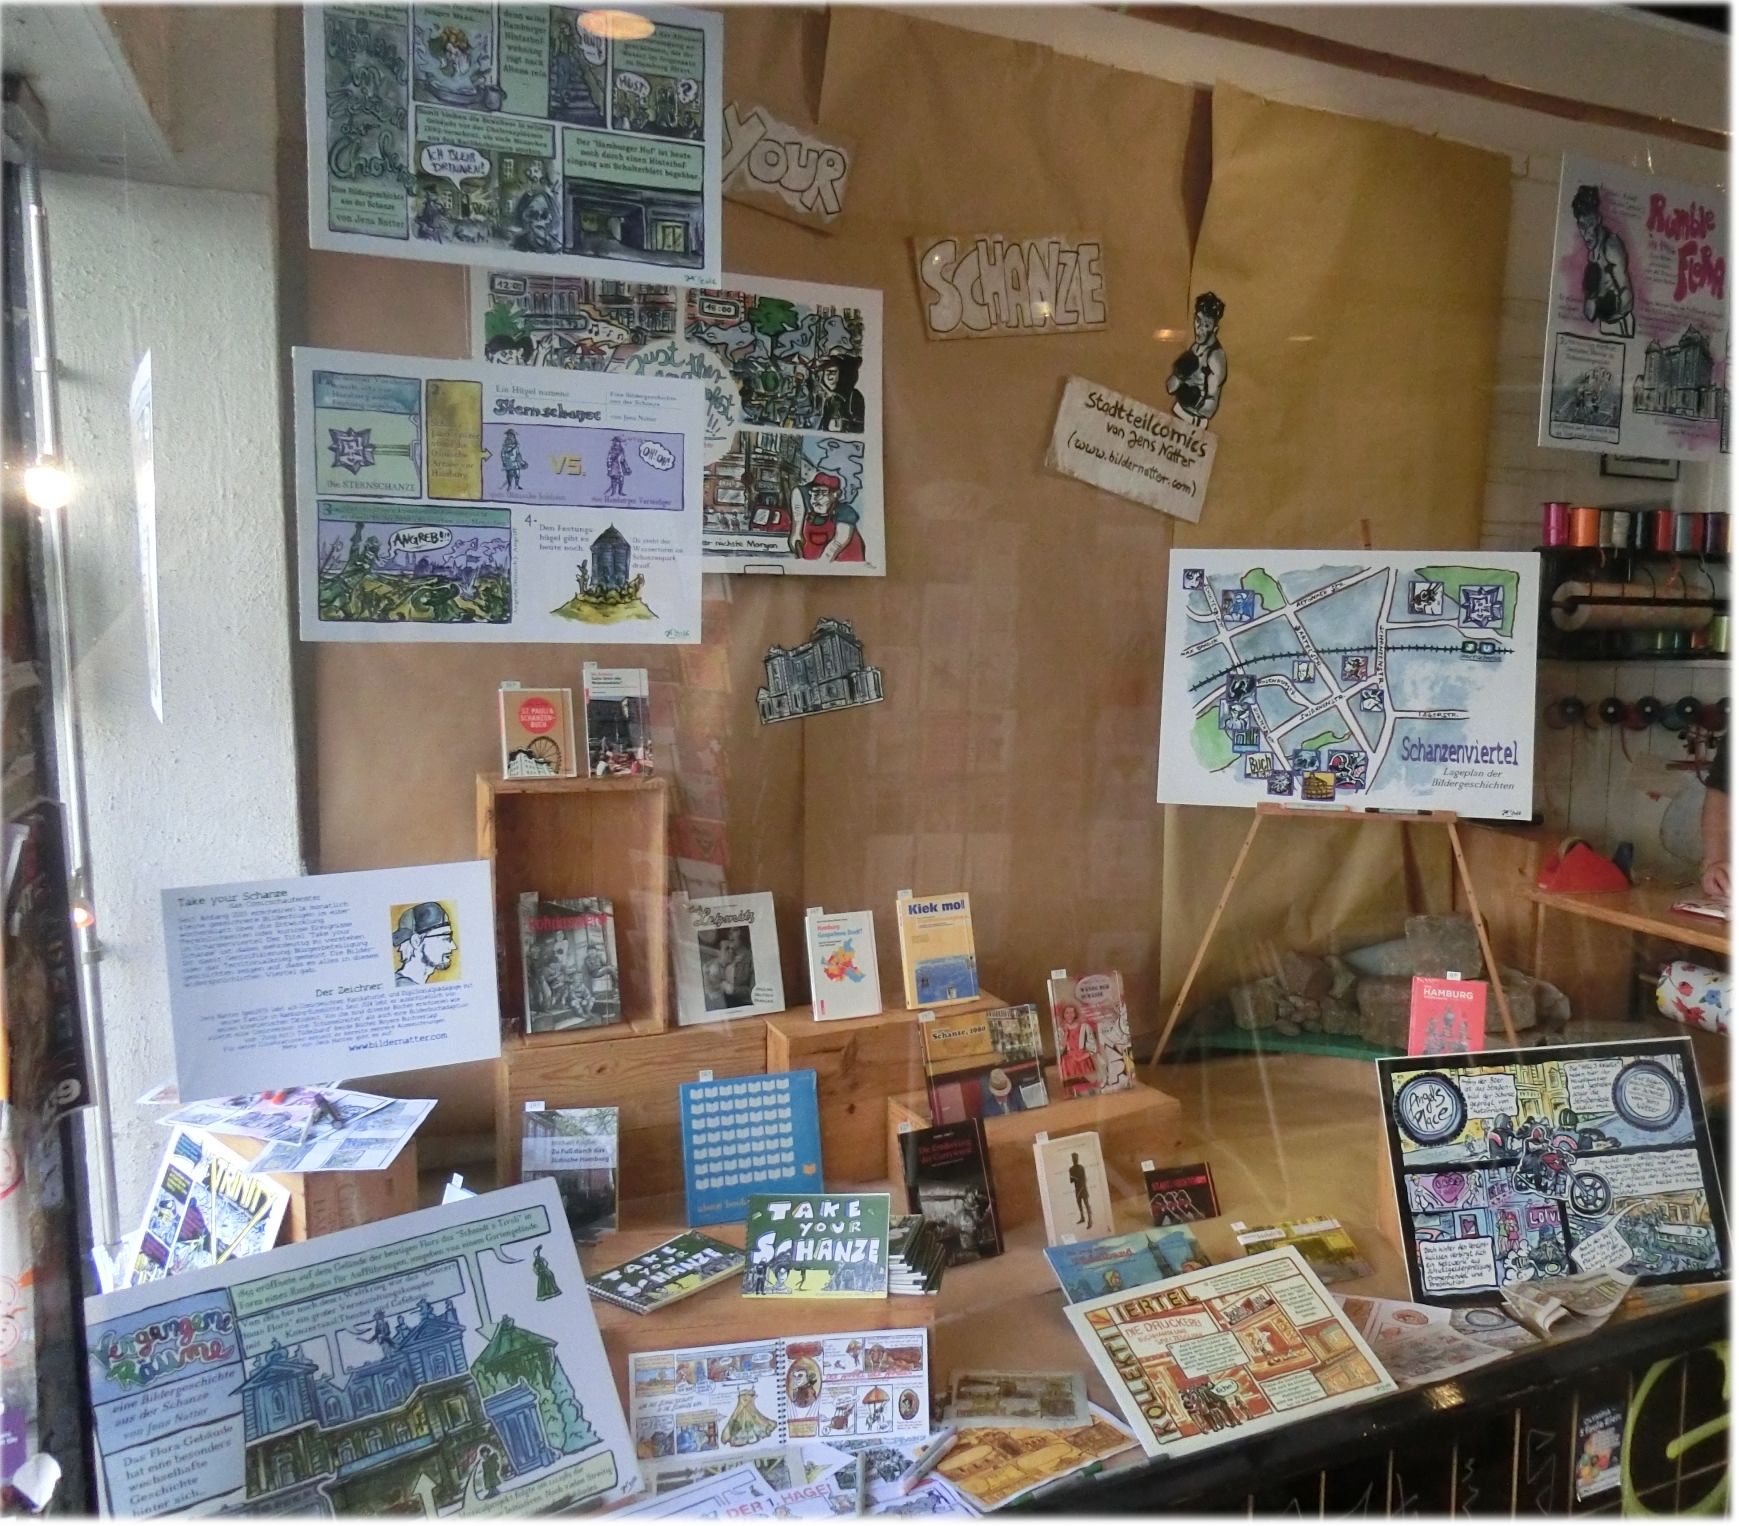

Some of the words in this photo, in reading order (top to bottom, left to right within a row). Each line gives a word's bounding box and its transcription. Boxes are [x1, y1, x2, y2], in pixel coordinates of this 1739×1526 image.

[576, 137, 590, 146] Der
[670, 149, 692, 160] heute
[580, 149, 599, 158] noch
[601, 151, 624, 161] durch
[625, 155, 648, 165] einen
[722, 101, 848, 217] YOUR
[1646, 193, 1717, 241] Rumble
[920, 238, 1107, 333] SCHANZE
[496, 384, 510, 394] Ein
[512, 385, 537, 398] Hügel
[1084, 391, 1209, 458] Stadtteilcomics
[1127, 430, 1157, 452] Jens
[1158, 442, 1197, 469] Natter
[547, 452, 588, 477] VS.
[342, 480, 417, 493] STERNSCHANZE
[539, 523, 556, 532] Den
[539, 533, 562, 544] hügel
[563, 535, 578, 545] gibt
[539, 544, 562, 552] heute
[632, 545, 674, 554] Wasserturm
[1401, 735, 1520, 766] Schanzenviertel
[1248, 753, 1273, 772] Buch
[1443, 767, 1485, 779] Lageplan
[1486, 769, 1504, 778] der
[1431, 778, 1516, 791] Bildergeschichten
[176, 896, 206, 907] Take
[209, 893, 239, 907] your
[242, 889, 289, 902] Schanze
[908, 901, 940, 916] Kiek
[200, 913, 229, 922] Anfang
[308, 901, 350, 911] monatlich
[254, 929, 274, 938] oder
[276, 926, 309, 936] kuriose
[310, 921, 353, 933] Ereignisse
[265, 935, 282, 943] Der
[318, 957, 340, 966] alles
[265, 969, 299, 979] Viertel
[315, 986, 335, 998] Der
[1423, 988, 1474, 1000] HAMBURG
[347, 1032, 449, 1052] www.bildernatter.com
[932, 1029, 970, 1040] Schanze,
[1412, 1106, 1453, 1130] Place
[767, 1200, 862, 1222] TAKE
[799, 1220, 862, 1237] YOUR
[255, 1275, 297, 1293] eröffnete
[298, 1272, 314, 1282] auf
[315, 1267, 333, 1278] dem
[333, 1257, 368, 1273] Gelände
[369, 1251, 382, 1262] der
[383, 1243, 419, 1260] heutigen
[419, 1239, 441, 1250] Flora
[441, 1234, 455, 1243] das
[524, 1213, 533, 1221] in
[751, 1230, 881, 1264] SCHANZE
[239, 1299, 264, 1310] Form
[264, 1291, 290, 1302] eines
[332, 1274, 347, 1285] für
[410, 1249, 445, 1263] umgeben
[446, 1245, 461, 1253] von
[461, 1238, 486, 1249] einem
[616, 1247, 724, 1297] SCHANZE
[240, 1316, 261, 1328] Von
[281, 1308, 295, 1318] bis
[297, 1302, 316, 1313] nach
[320, 1300, 337, 1309] dem
[343, 1284, 387, 1300] Weltkrieg
[388, 1279, 404, 1288] war
[405, 1273, 420, 1284] das
[245, 1340, 262, 1351] mit
[340, 1309, 372, 1323] Theater
[374, 1302, 390, 1313] und
[295, 1315, 310, 1325] ein
[311, 1307, 337, 1323] großer
[1124, 1325, 1144, 1338] DIE
[1143, 1317, 1204, 1333] DRUCKEREI
[112, 1398, 138, 1414] eine
[141, 1369, 236, 1407] Bildergeschichte
[114, 1416, 136, 1427] aus
[138, 1406, 158, 1420] der
[162, 1391, 210, 1412] Schanze
[124, 1428, 144, 1440] von
[146, 1418, 172, 1436] Jens
[175, 1407, 210, 1425] Natter
[123, 1453, 147, 1467] Das
[149, 1424, 235, 1458] Flora-Gebäude
[126, 1465, 147, 1481] hat
[148, 1460, 173, 1474] eine
[174, 1438, 233, 1462] besonders
[128, 1459, 209, 1493] wechselhafte
[130, 1477, 200, 1506] Geschichte
[132, 1498, 170, 1518] hinter
[725, 1499, 766, 1519] DER
